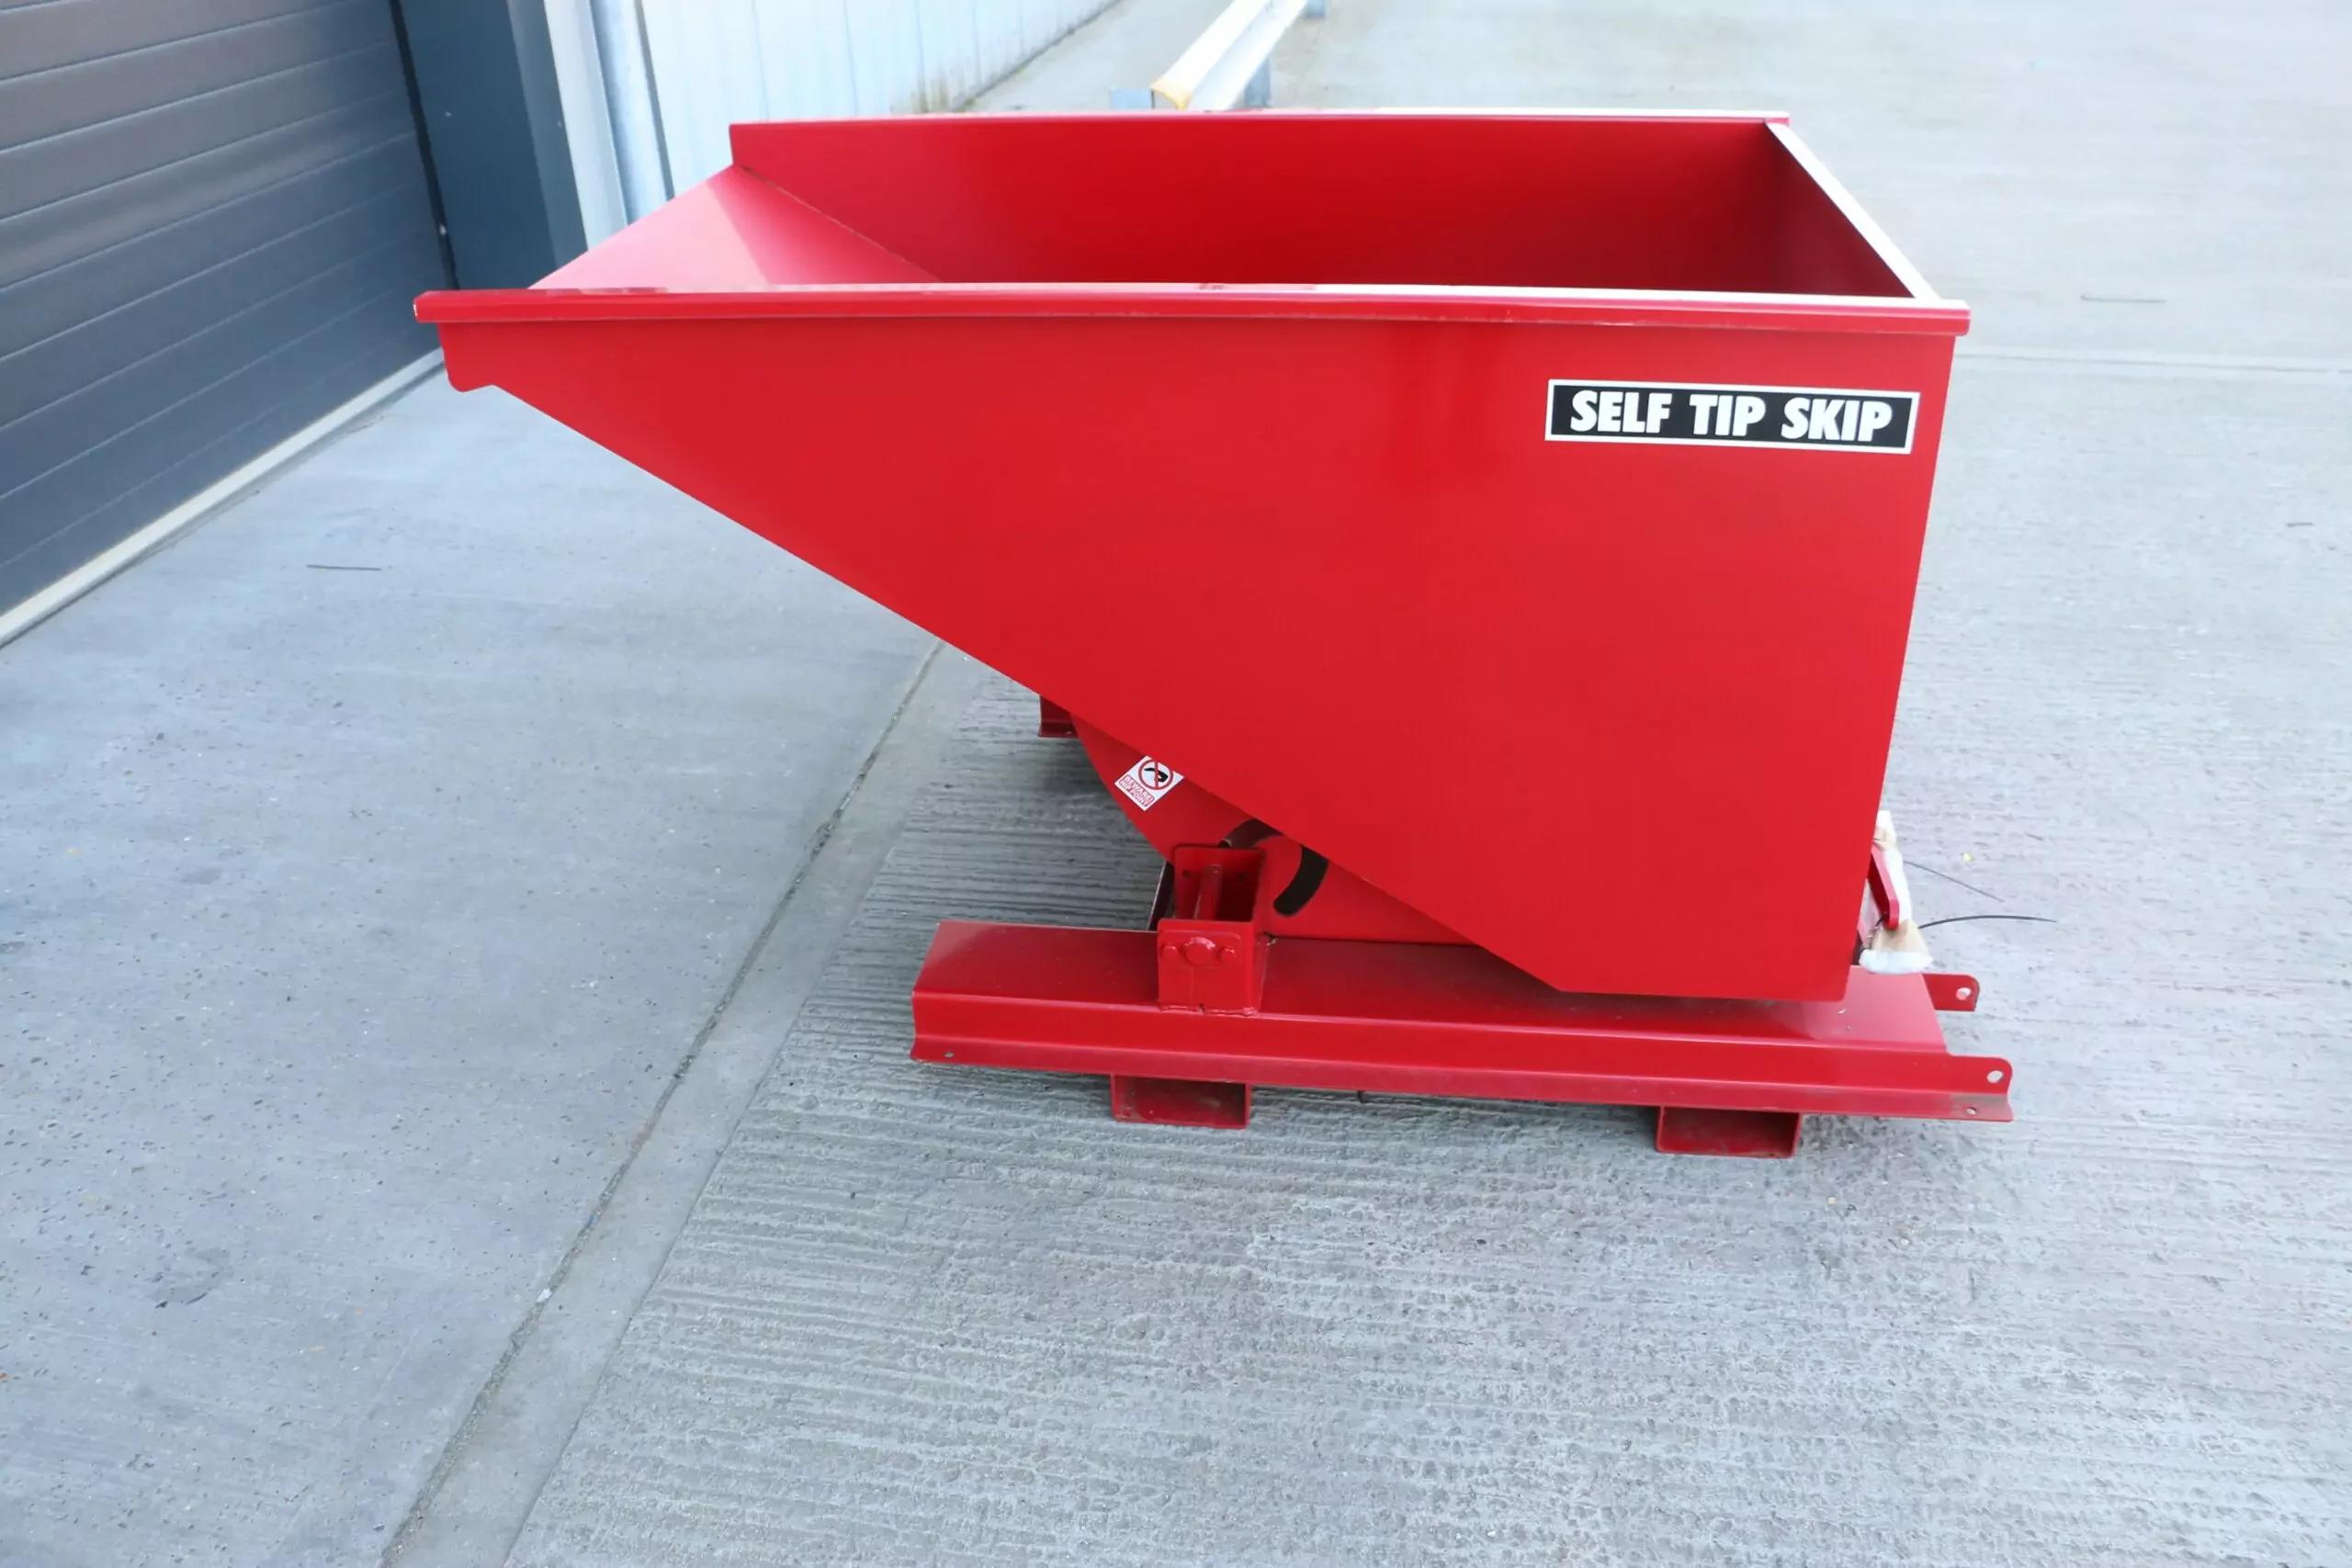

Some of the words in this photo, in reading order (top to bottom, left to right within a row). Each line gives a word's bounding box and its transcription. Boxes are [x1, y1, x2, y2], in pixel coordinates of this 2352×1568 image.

[1570, 390, 1673, 434] SELF
[1690, 394, 1766, 437] TIP
[1781, 398, 1894, 443] SKIP
[1119, 780, 1131, 791] NIP
[1129, 789, 1148, 806] POINT
